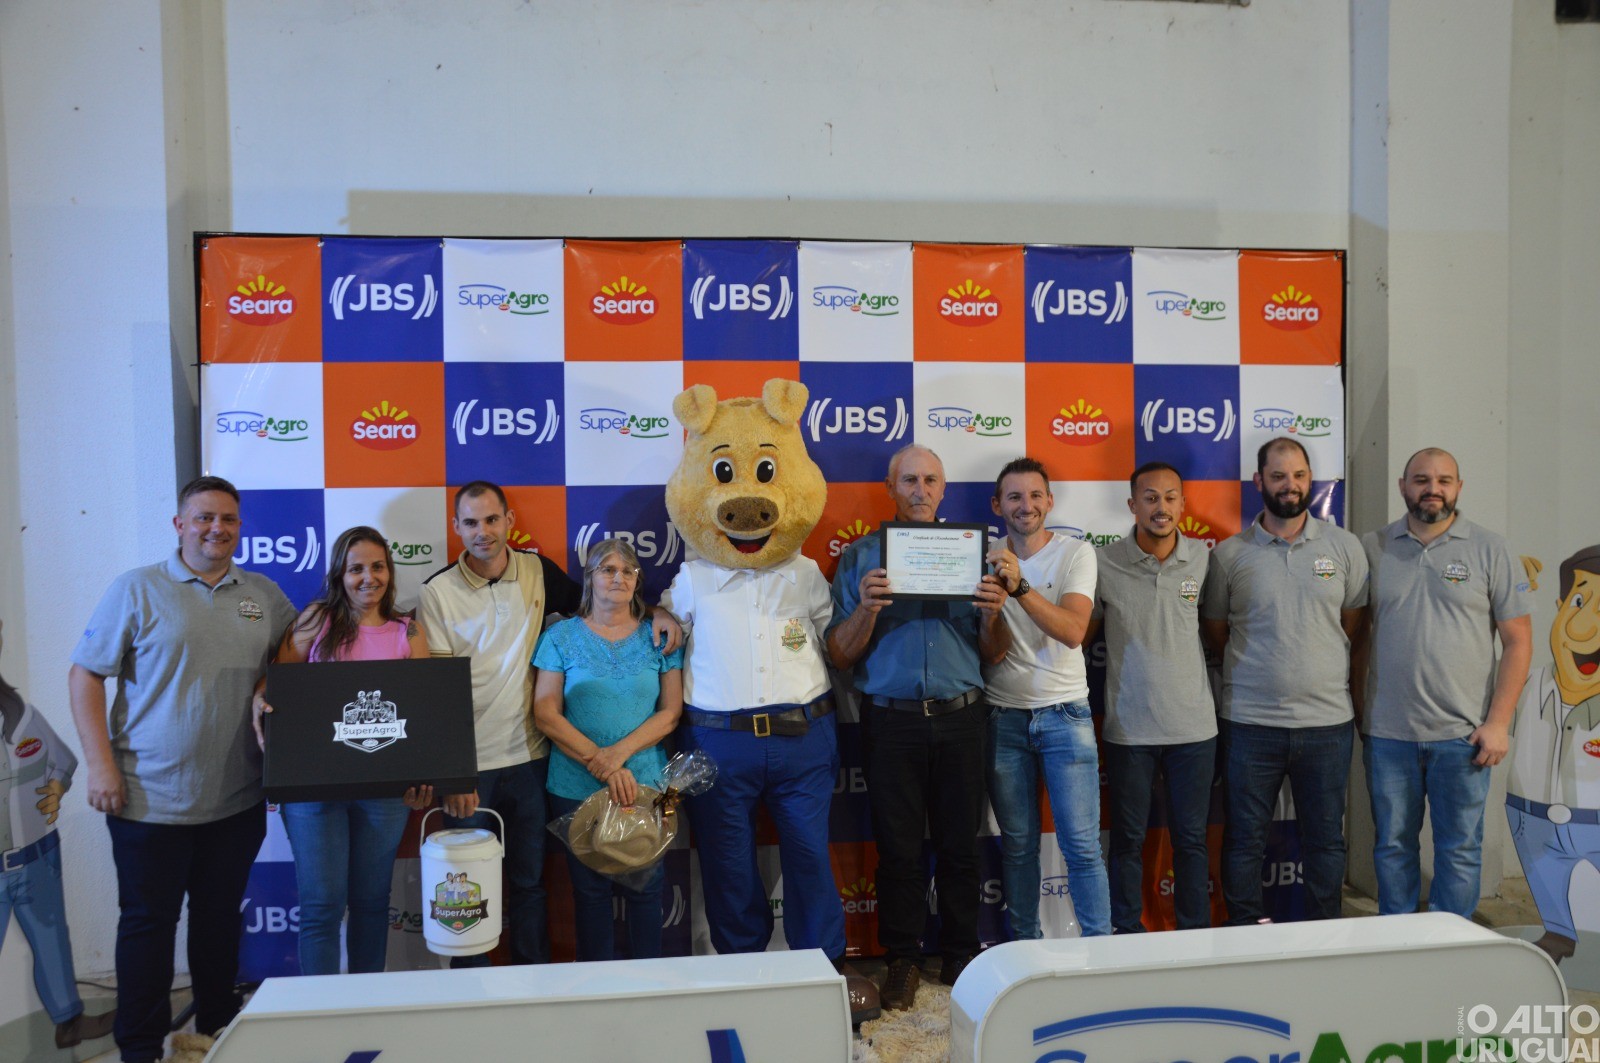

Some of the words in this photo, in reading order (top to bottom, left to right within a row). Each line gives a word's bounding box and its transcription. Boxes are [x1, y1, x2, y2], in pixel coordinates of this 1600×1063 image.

[229, 296, 293, 314] Seara
[349, 284, 414, 311] JBS
[458, 290, 549, 310] SuperAgro
[593, 296, 654, 314] Seara
[709, 284, 771, 312] JBS
[813, 292, 899, 310] SuperAgro
[1050, 288, 1108, 316] JBS
[940, 299, 998, 317] Seara
[1264, 303, 1319, 322] Seara
[216, 417, 309, 437] SuperAgro
[472, 408, 537, 436] JBS
[580, 414, 669, 433] SuperAgro
[826, 406, 887, 434] JBS
[928, 412, 1012, 431] SuperAgro
[1053, 418, 1109, 436] Seara
[1159, 407, 1215, 434] JBS
[1253, 413, 1331, 432] SuperAgro
[353, 422, 416, 440] Seara
[232, 535, 297, 565] JBS
[343, 727, 397, 736] SuperAgro
[434, 907, 481, 918] SuperAgro
